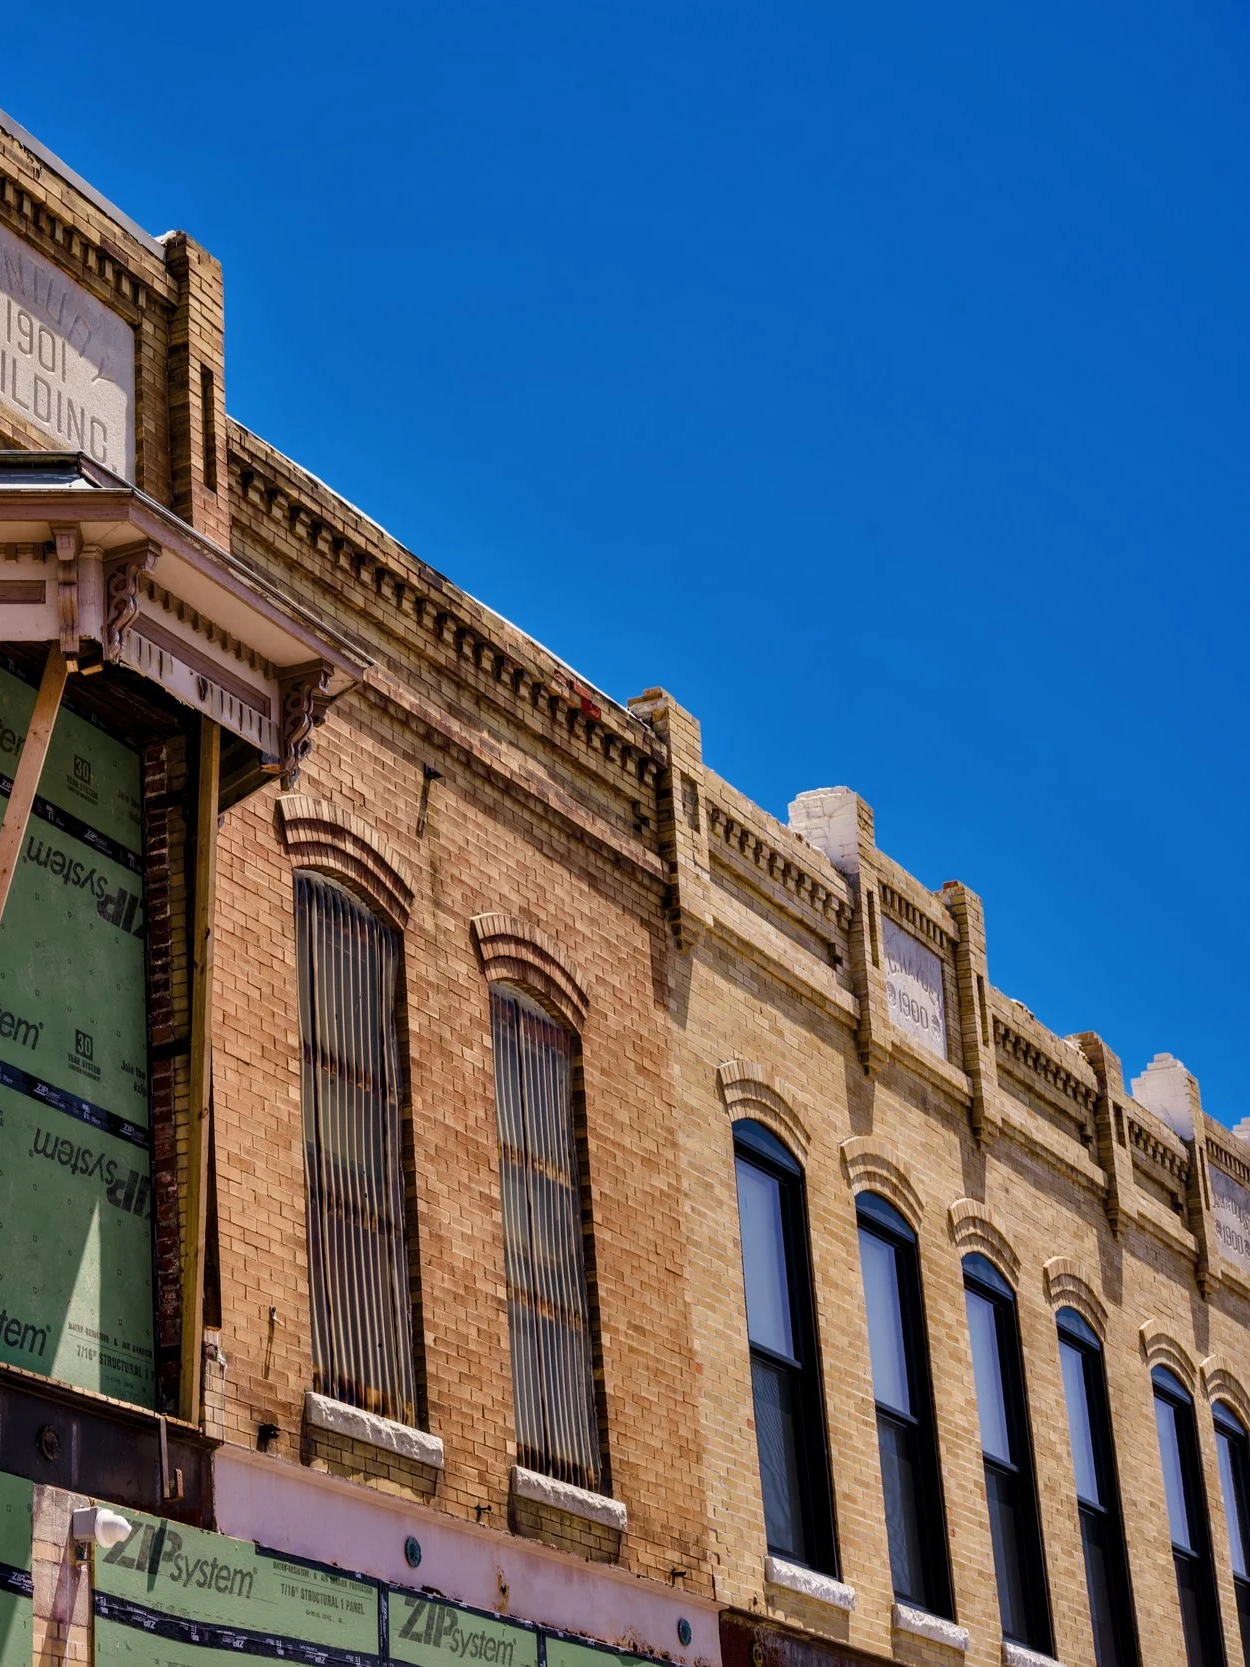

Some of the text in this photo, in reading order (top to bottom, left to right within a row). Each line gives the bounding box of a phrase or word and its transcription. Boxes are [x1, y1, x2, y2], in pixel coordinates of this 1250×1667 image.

[6, 299, 67, 384] 1901
[74, 756, 91, 782] 30
[897, 988, 929, 1031] 1900
[76, 1032, 92, 1058] 30
[1222, 1223, 1244, 1256] 1900
[76, 1343, 97, 1362] 7/16"
[98, 1350, 143, 1379] STRUCTURAL
[281, 1583, 365, 1616] 7/16" STRUCTURAL 1 PANEL
[398, 1594, 515, 1667] ZIPsystem
